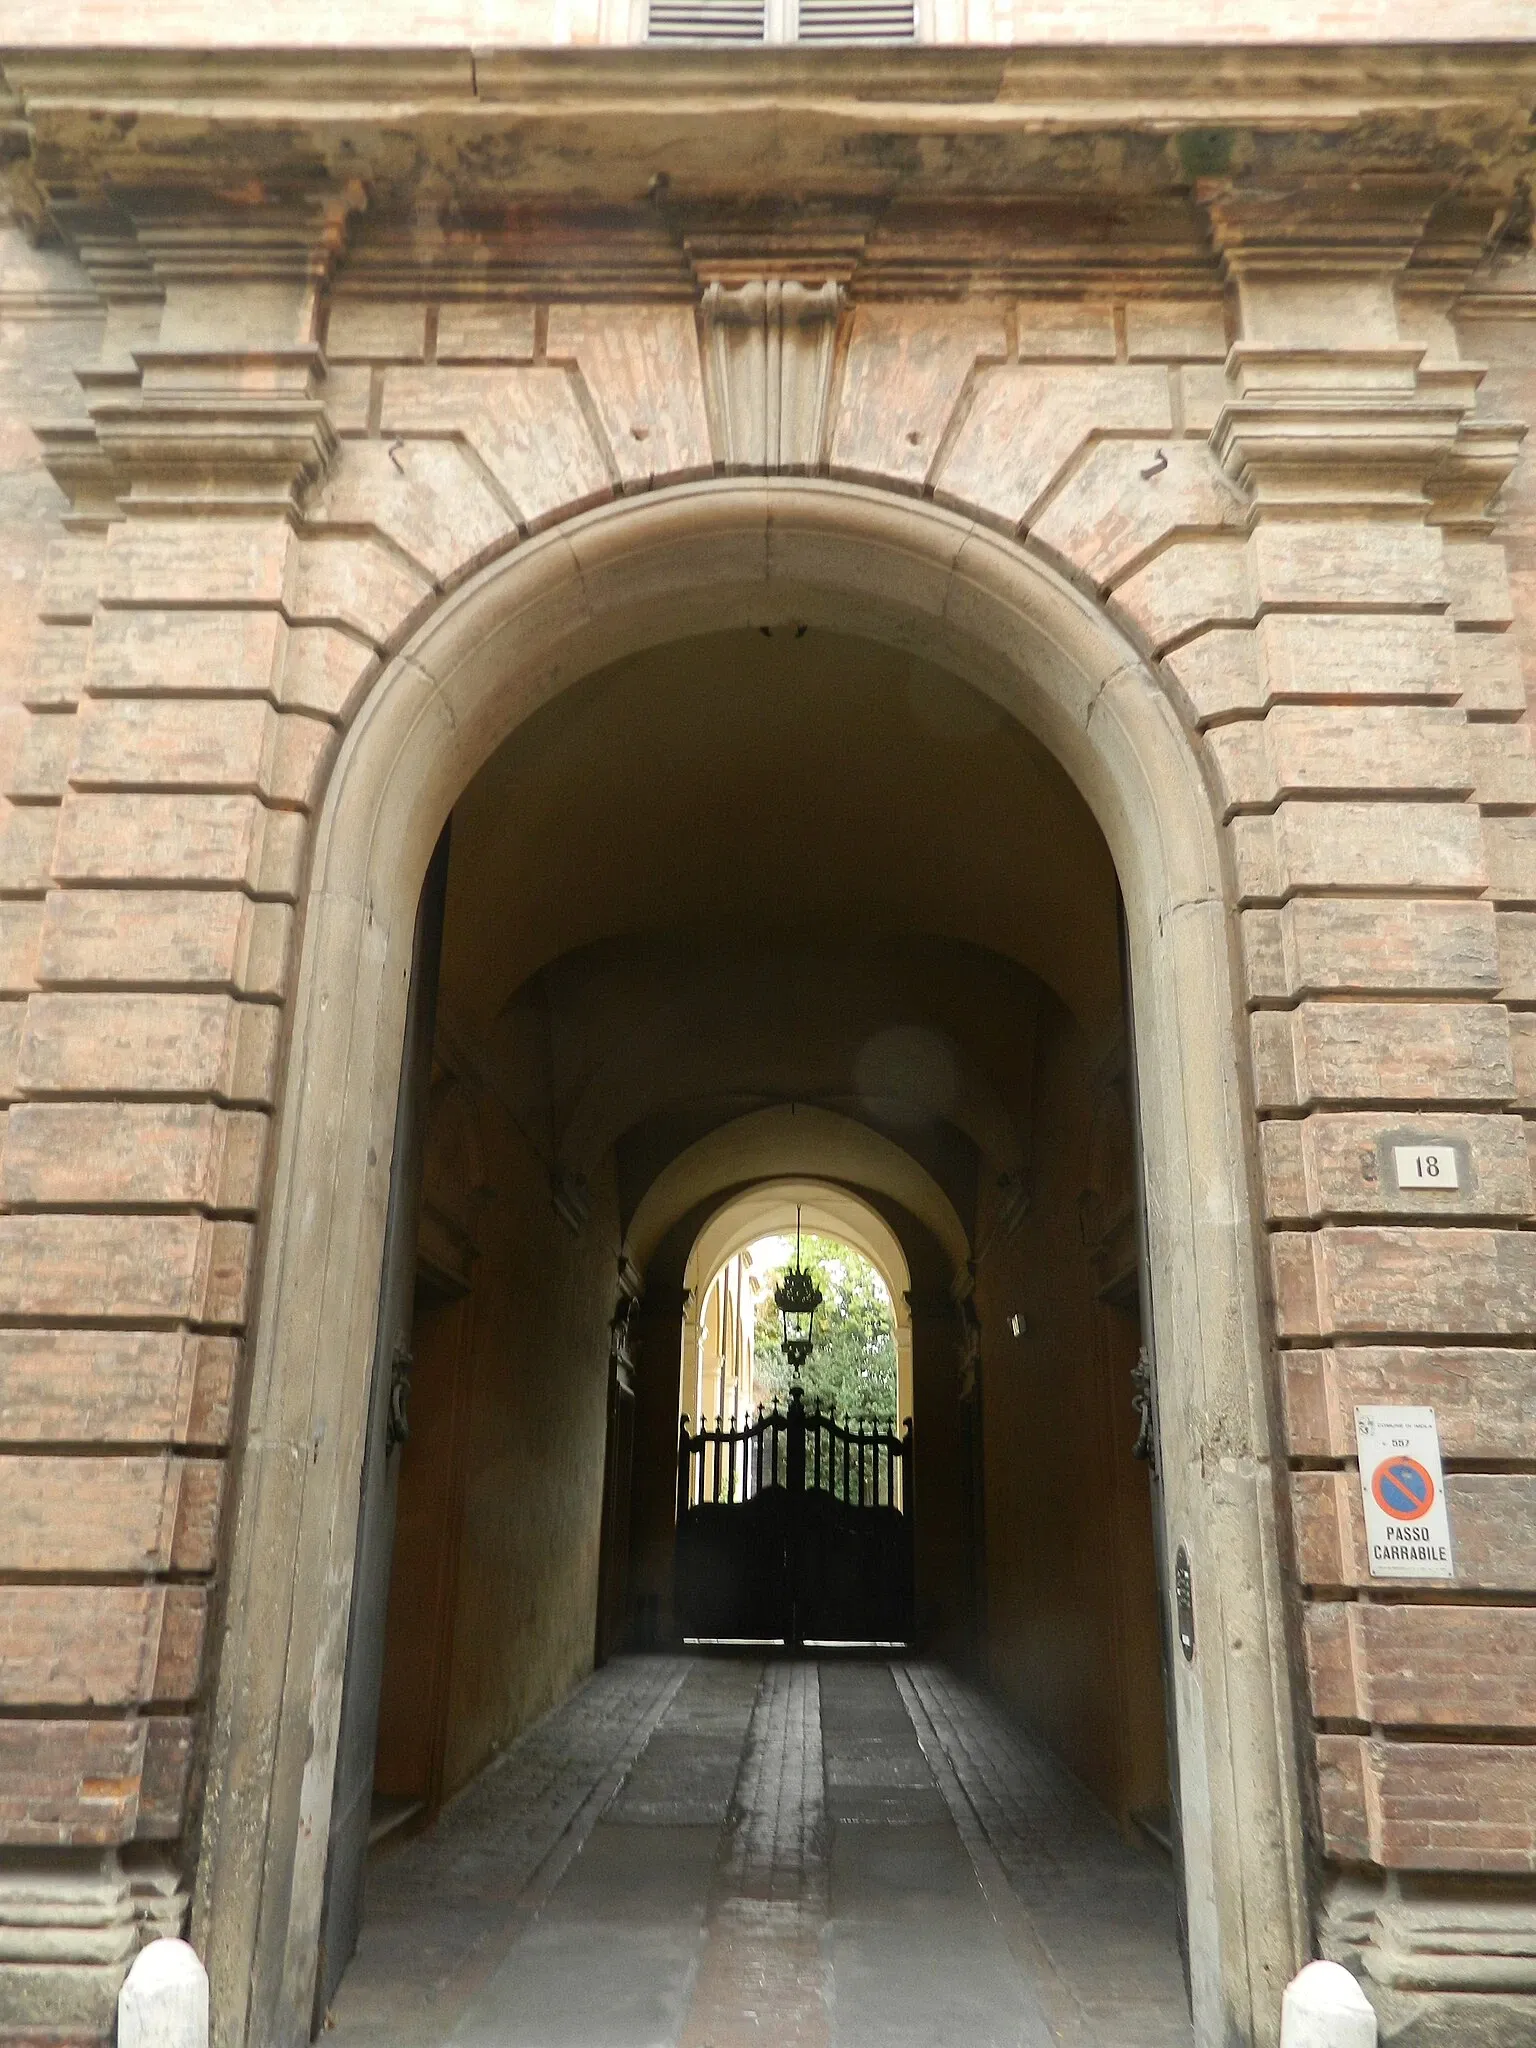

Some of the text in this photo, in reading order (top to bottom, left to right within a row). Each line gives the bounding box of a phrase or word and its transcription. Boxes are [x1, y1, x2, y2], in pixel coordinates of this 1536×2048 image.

[1416, 1155, 1440, 1178] 18
[1386, 1526, 1429, 1541] PASSO
[1374, 1545, 1448, 1561] CARRABILE
